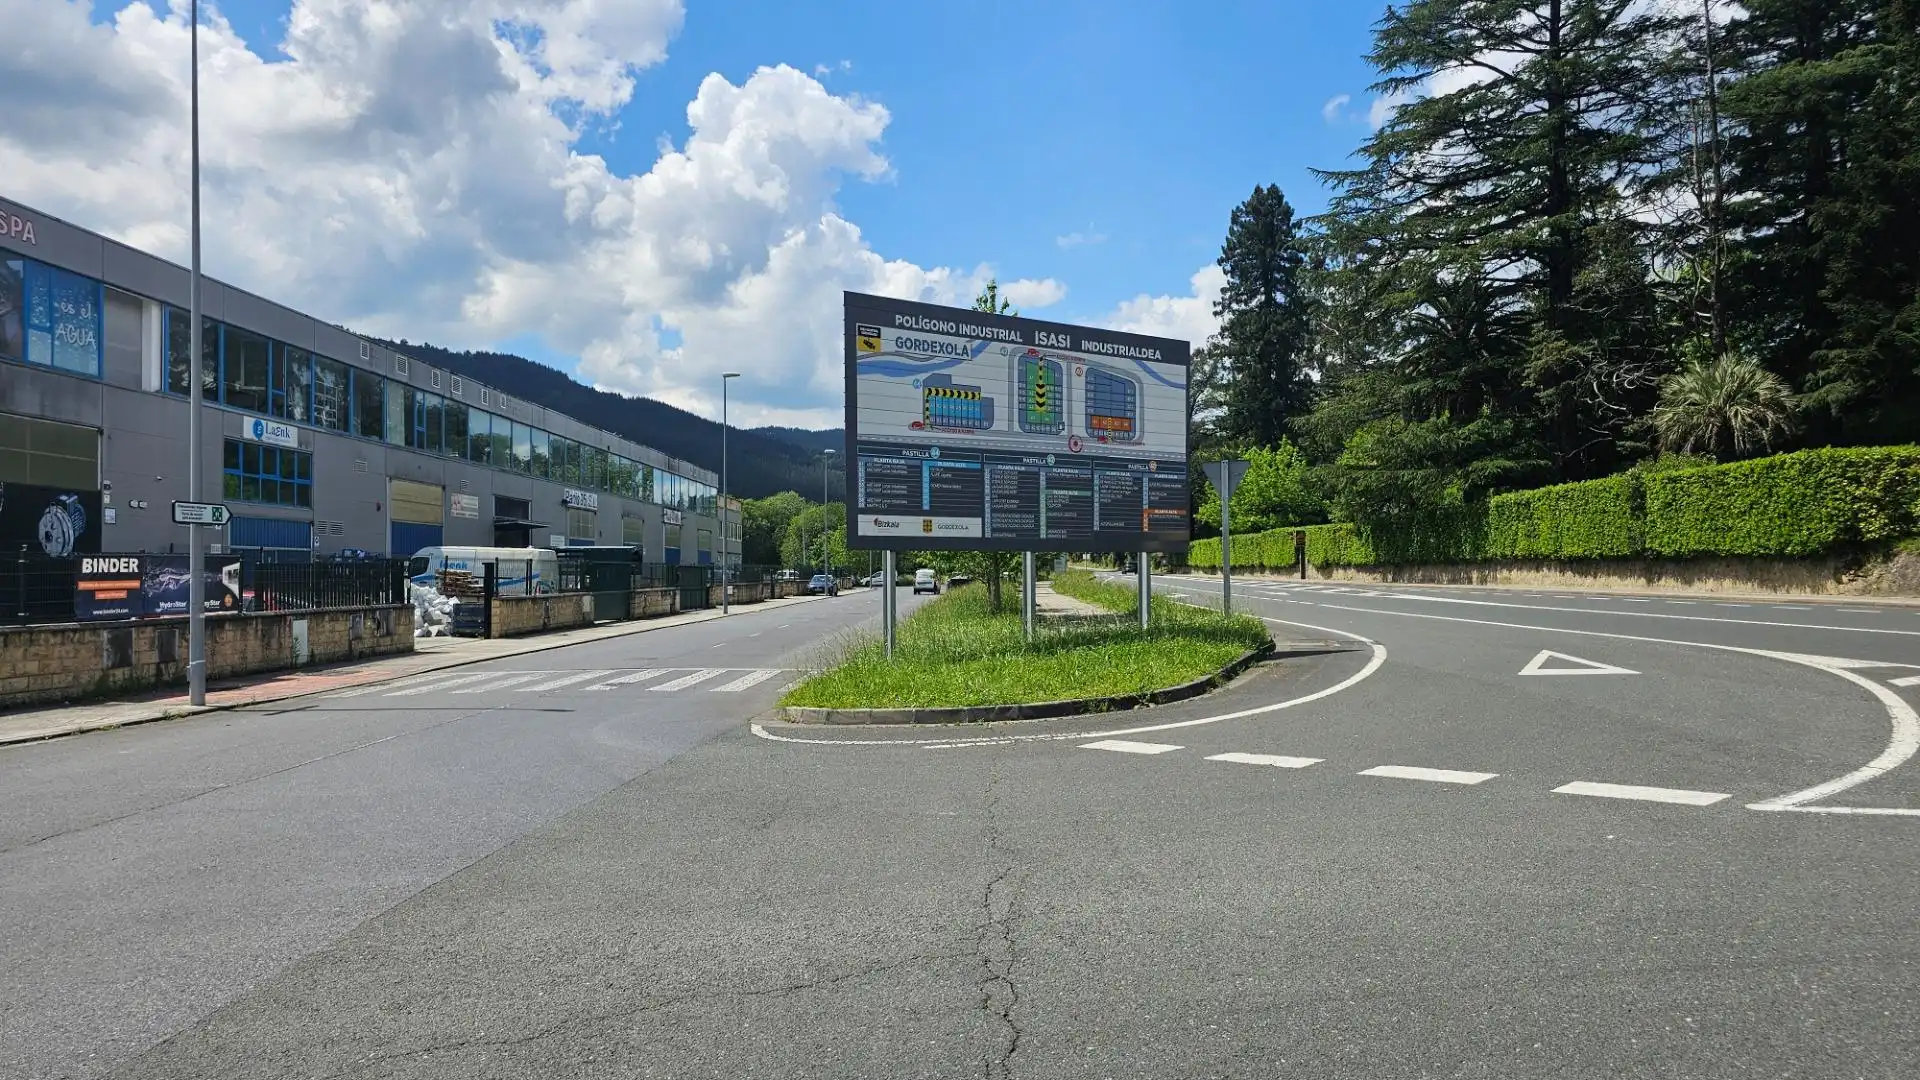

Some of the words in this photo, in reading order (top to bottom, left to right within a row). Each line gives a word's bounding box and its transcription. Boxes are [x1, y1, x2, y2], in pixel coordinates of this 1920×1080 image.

[55, 323, 97, 350] AGUA
[895, 314, 957, 333] POLÍGONO
[959, 323, 1023, 343] INDUSTRIAL
[1034, 330, 1071, 348] ISASI
[1081, 339, 1162, 360] INDUSTRIALDEA
[895, 336, 970, 358] GORDEXOLA
[82, 558, 139, 573] BINDER
